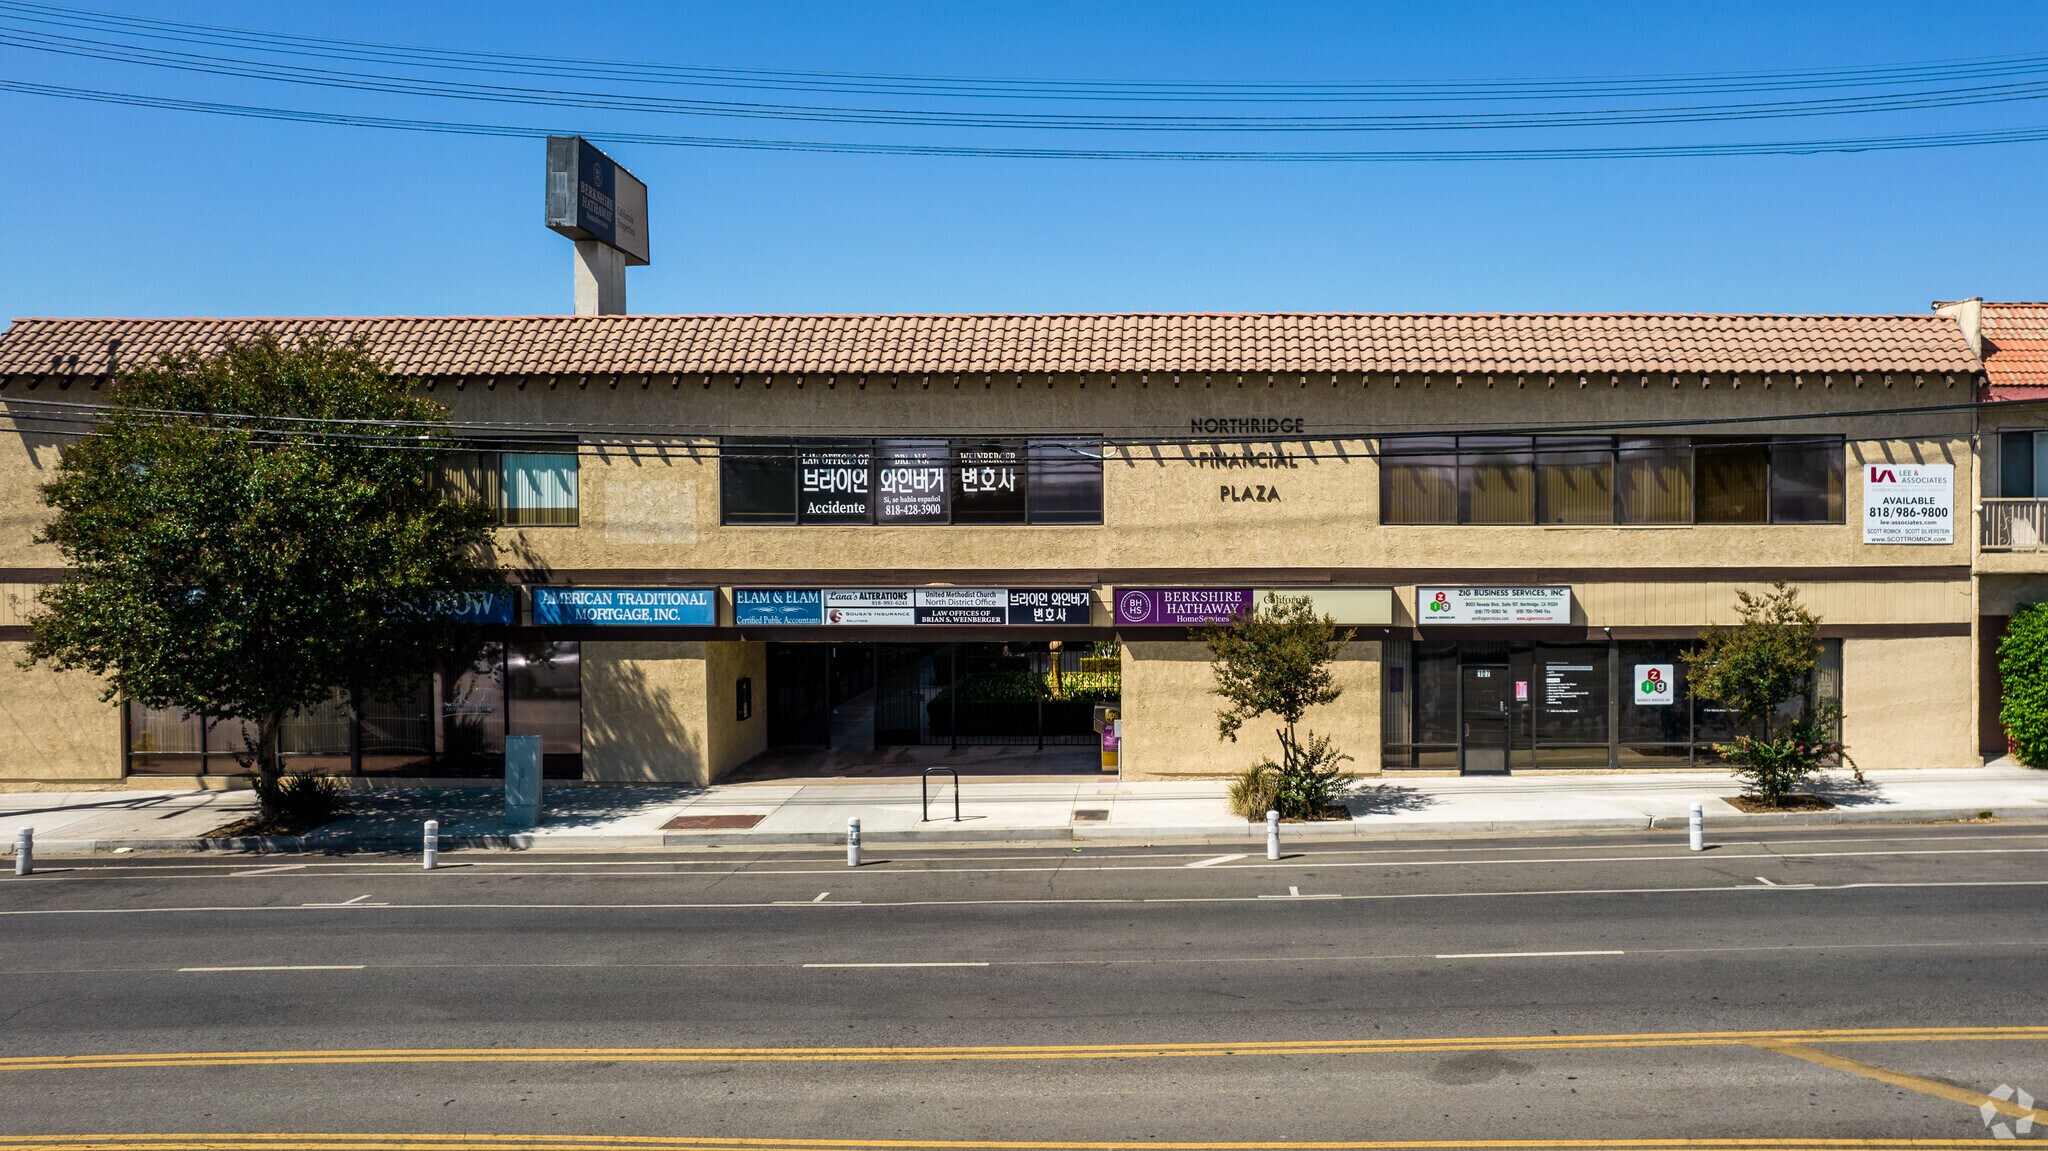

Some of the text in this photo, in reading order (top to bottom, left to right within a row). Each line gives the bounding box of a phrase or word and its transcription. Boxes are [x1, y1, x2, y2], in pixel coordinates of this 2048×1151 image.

[580, 181, 614, 211] BERKSHIRE
[582, 195, 612, 222] HATHAWAY
[1191, 418, 1304, 433] NORTHRIDGE
[802, 452, 1017, 465] LAW OFFICES OF BRIAN S. WEINBERGER
[1199, 451, 1299, 469] FINANCIAL
[803, 466, 1016, 493] 브라이언 와인버거 변호사
[917, 495, 941, 504] español
[1220, 485, 1282, 502] PLAZA
[1882, 497, 1935, 505] AVAILABLE
[806, 501, 866, 514] Accidente
[885, 504, 941, 516] 818-428-3900
[1869, 507, 1948, 518] 818/986-9800
[541, 592, 707, 605] AMERICAN TRADITIONAL
[736, 591, 820, 604] ELAM & ELAM
[829, 591, 908, 600] Lana's ALTERATIONS
[925, 590, 996, 598] United Methodist Church
[1010, 592, 1089, 606] 브라이언 와인버거
[1164, 591, 1242, 602] BERKSHIRE
[1511, 589, 1547, 597] SERVICES,
[925, 598, 996, 606] North District Office
[1129, 599, 1142, 607] BH
[575, 608, 680, 621] MORTGAGE, INC.
[1129, 606, 1142, 614] HS
[1167, 603, 1239, 614] HATHAWAY
[736, 615, 821, 624] Certified Public Accountants
[1033, 608, 1067, 622] 변호사
